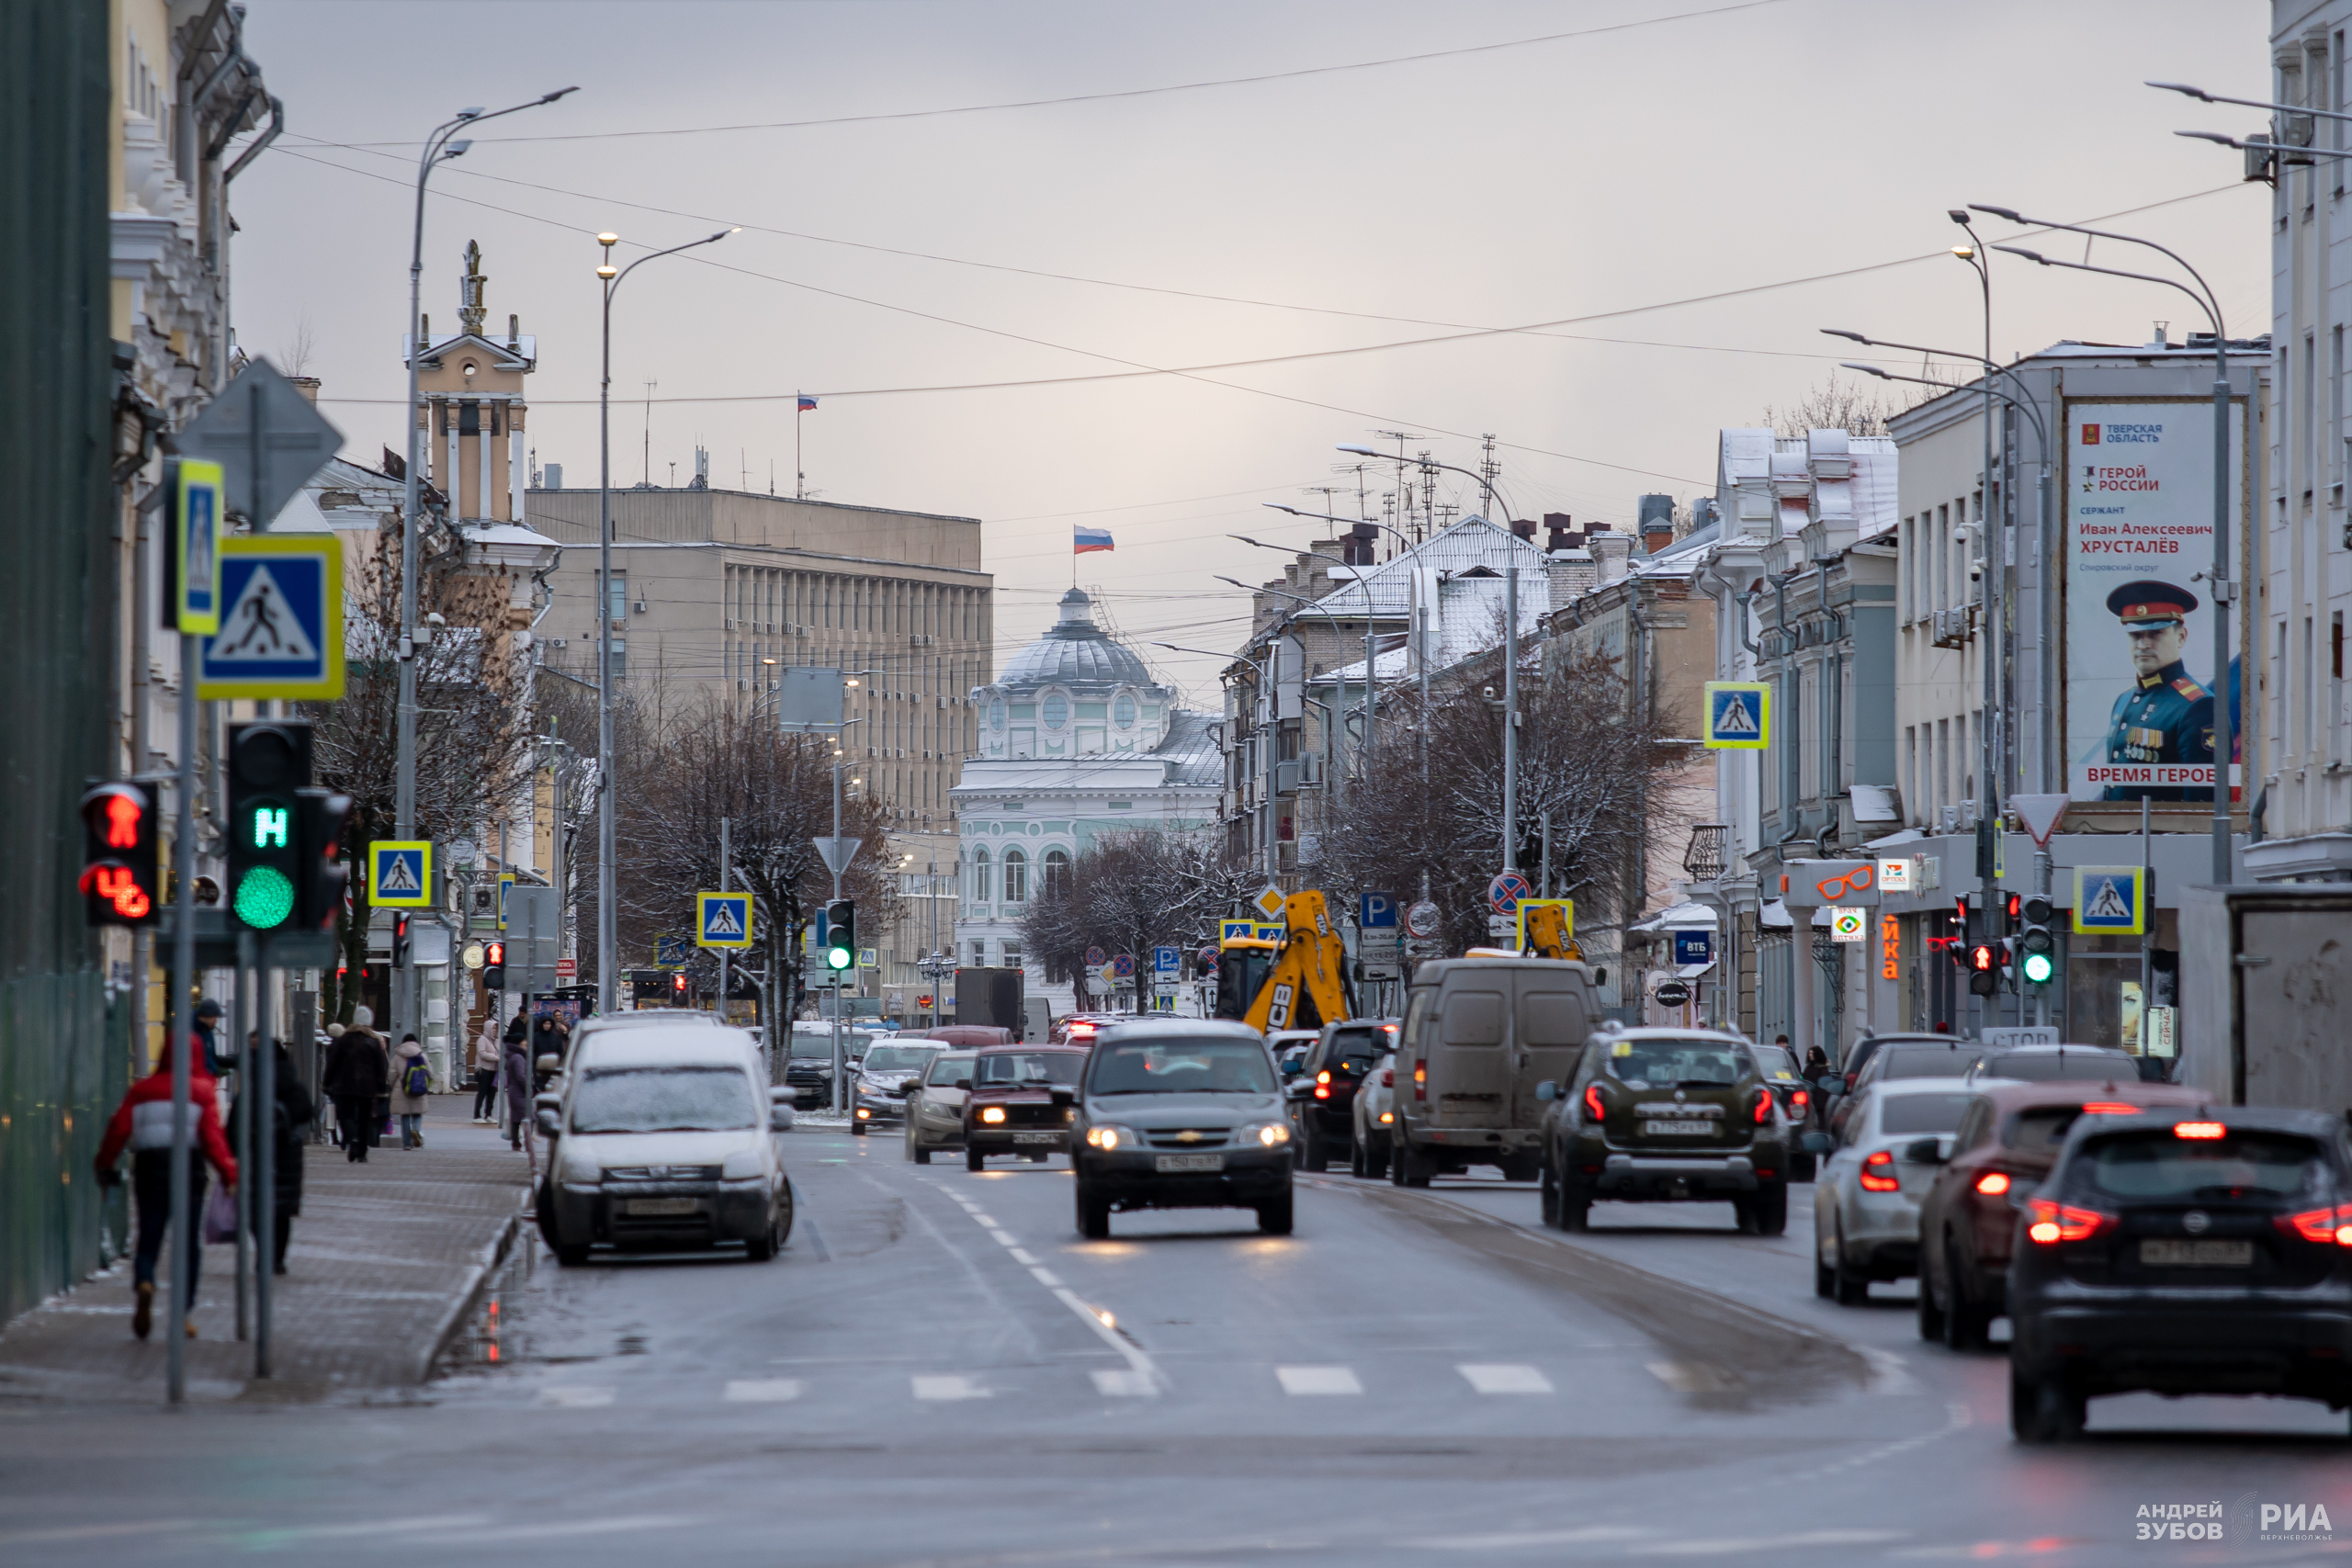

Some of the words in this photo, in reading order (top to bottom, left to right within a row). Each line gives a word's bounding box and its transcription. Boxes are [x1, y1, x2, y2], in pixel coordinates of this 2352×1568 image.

[2107, 424, 2162, 433] ТВЕРСКАЯ
[2107, 434, 2159, 443] ОБЛАСТЬ
[2099, 465, 2146, 479] ГЕРОЙ
[2098, 480, 2159, 491] РОССИИ
[2080, 507, 2125, 515] СЕРЖАНТ
[2080, 524, 2117, 535] Иван
[2120, 523, 2212, 535] Алексеевич
[2080, 537, 2179, 553] ХРУСТАЛЁВ
[2079, 564, 2132, 572] Спировский
[2087, 768, 2151, 782] ВРЕМЯ
[2157, 768, 2216, 782] ГЕРОЕ
[1687, 942, 1706, 952] ВТБ
[2163, 1008, 2171, 1045] СЕЙЧАС
